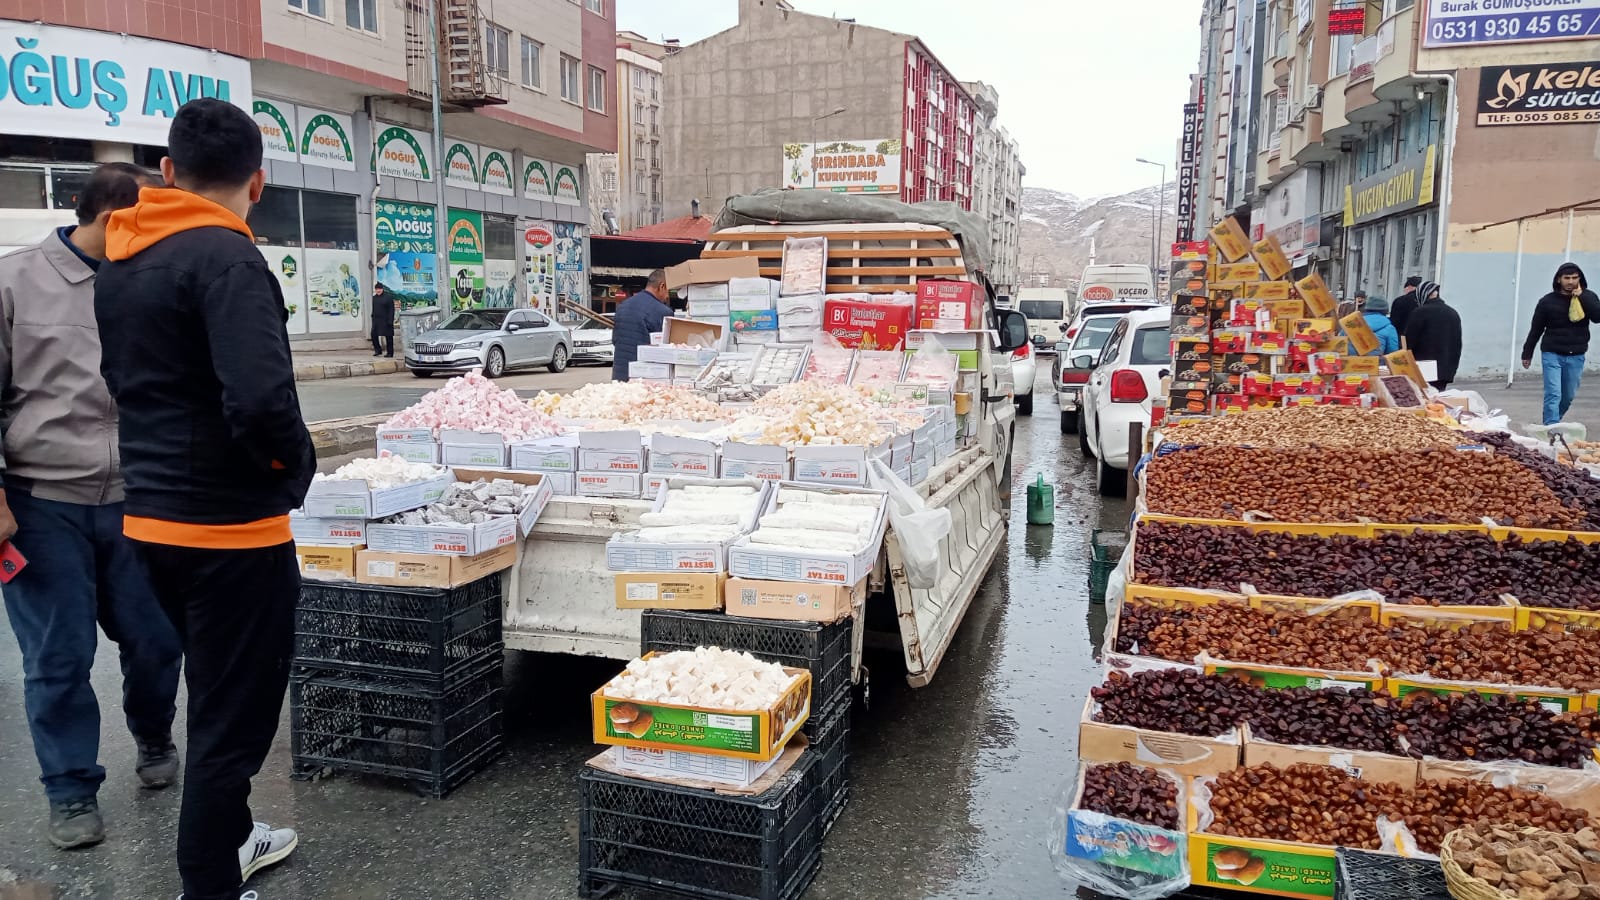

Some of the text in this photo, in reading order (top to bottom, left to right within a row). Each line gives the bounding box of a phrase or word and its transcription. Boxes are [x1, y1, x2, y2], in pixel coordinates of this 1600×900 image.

[1440, 1, 1478, 13] Burak
[1432, 20, 1477, 40] 0531
[1484, 18, 1520, 37] 930
[1525, 16, 1551, 34] 45
[1556, 14, 1582, 32] 65
[0, 36, 128, 127] ĞUŞ
[1514, 113, 1549, 123] 0505
[1553, 112, 1579, 121] 085
[313, 134, 341, 150] DOĞUŞ
[1184, 113, 1195, 161] HOTEL
[384, 149, 415, 167] DOĞUŞ
[1181, 167, 1191, 215] ROYAL
[1356, 182, 1385, 218] UYGUN
[395, 216, 433, 235] DOĞUŞ
[1118, 288, 1148, 297] KOÇERO
[654, 722, 704, 733] ZAHEDI DATES
[1270, 865, 1331, 877] ZAHEDI DATES
